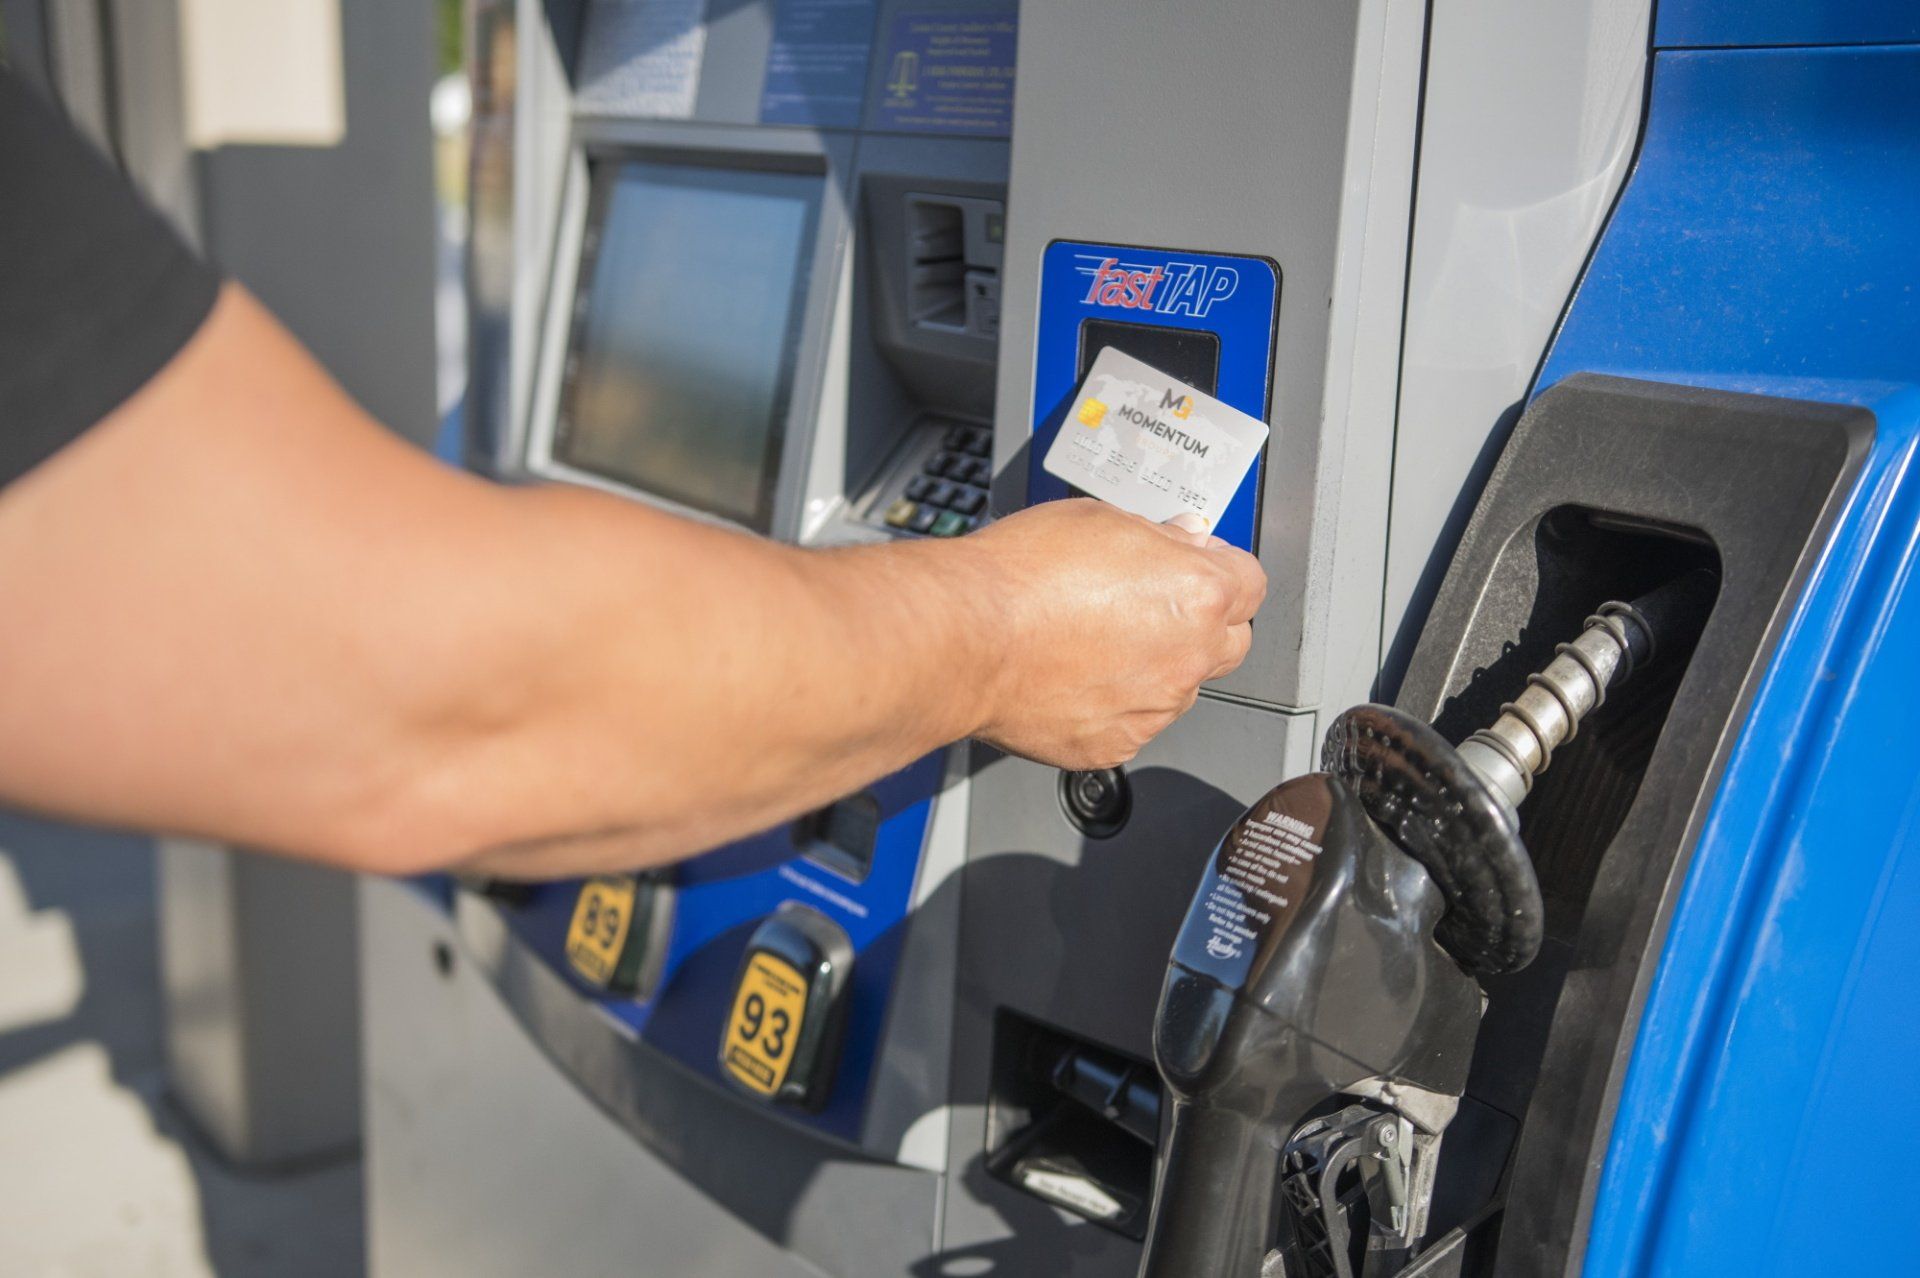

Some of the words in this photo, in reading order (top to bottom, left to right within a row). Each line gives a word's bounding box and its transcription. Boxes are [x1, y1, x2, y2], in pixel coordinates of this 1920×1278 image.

[1118, 404, 1209, 459] MOMENTUM
[1264, 811, 1315, 840] WARNING
[581, 893, 620, 950] 89
[738, 992, 790, 1060] 93
